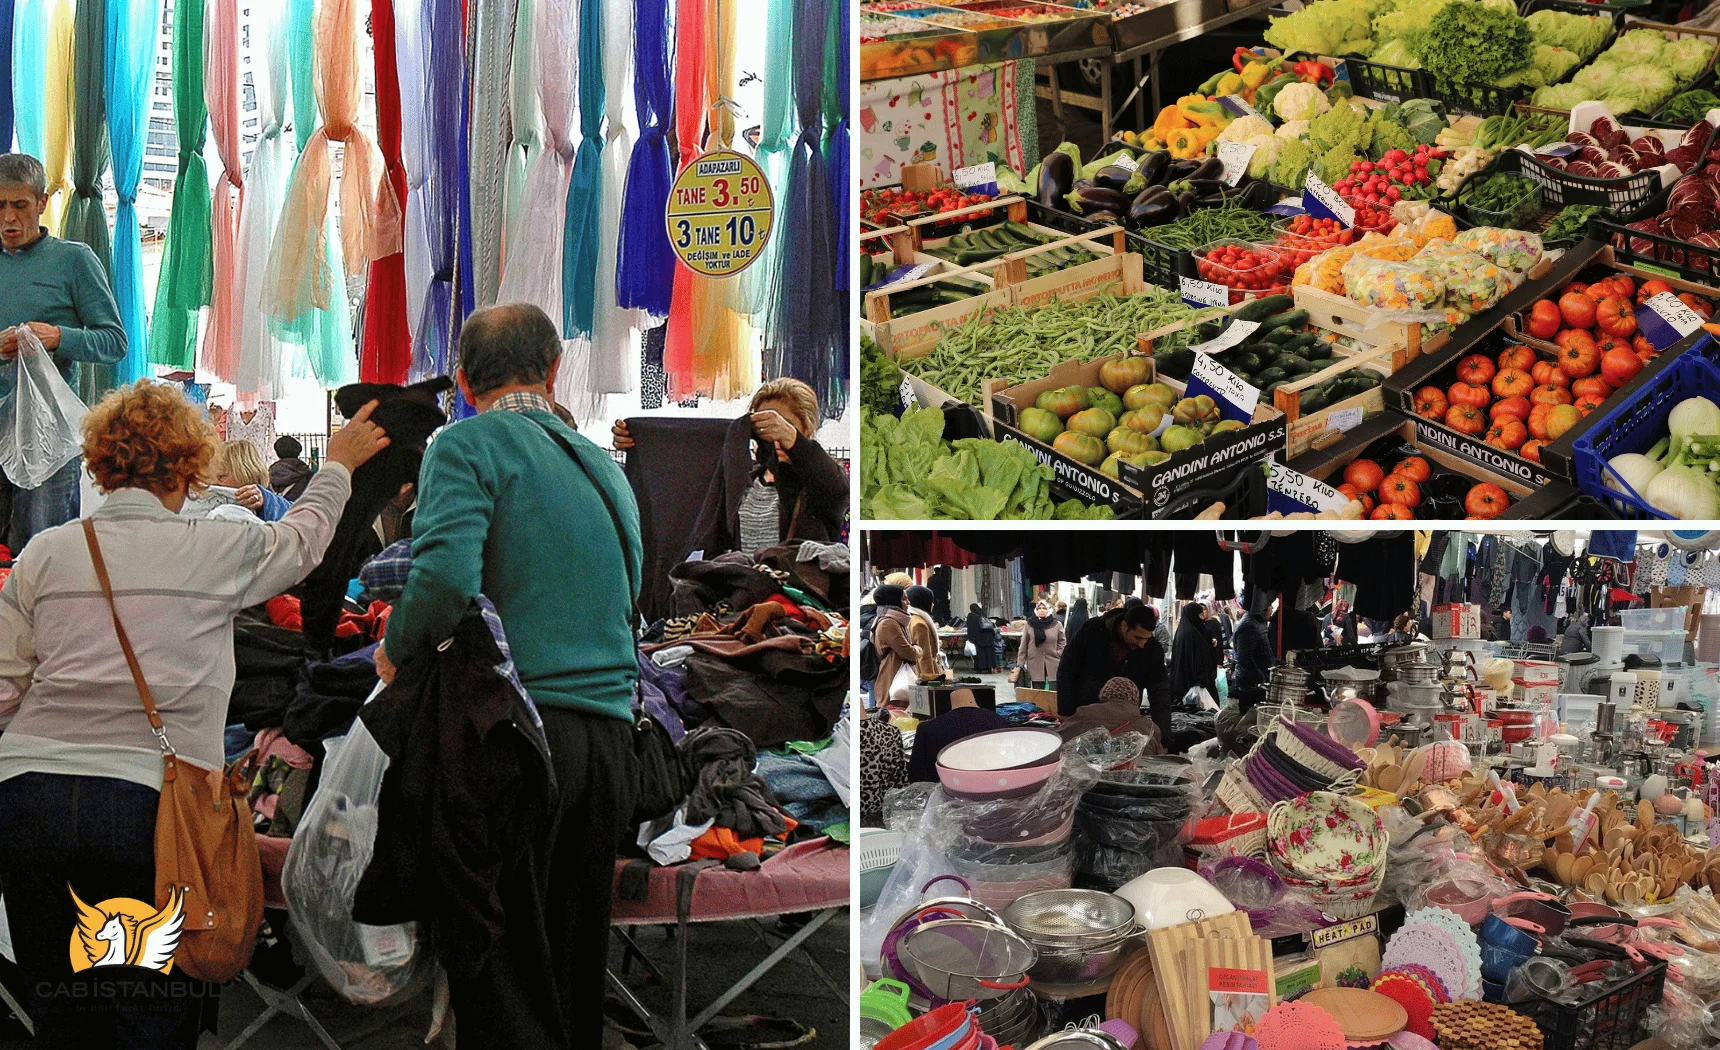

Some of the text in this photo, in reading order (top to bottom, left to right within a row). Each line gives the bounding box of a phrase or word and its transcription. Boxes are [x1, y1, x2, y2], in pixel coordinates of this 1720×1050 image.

[699, 161, 740, 174] ADAPAZARLI
[677, 187, 706, 205] TANE
[712, 176, 760, 207] 3.50
[677, 219, 691, 248] 3
[696, 226, 720, 246] TANE
[726, 215, 755, 246] 10
[705, 260, 731, 269] YOKTUR
[1181, 277, 1204, 288] 6,50
[1197, 353, 1224, 376] 4,50
[1152, 455, 1209, 488] GANDINI
[1210, 432, 1266, 466] ANTONIO
[1460, 442, 1532, 479] ANTONIO
[1053, 460, 1110, 498] ANTONIO
[1270, 464, 1304, 487] 5,50
[1319, 929, 1343, 943] HEAT
[1353, 921, 1372, 933] PAD
